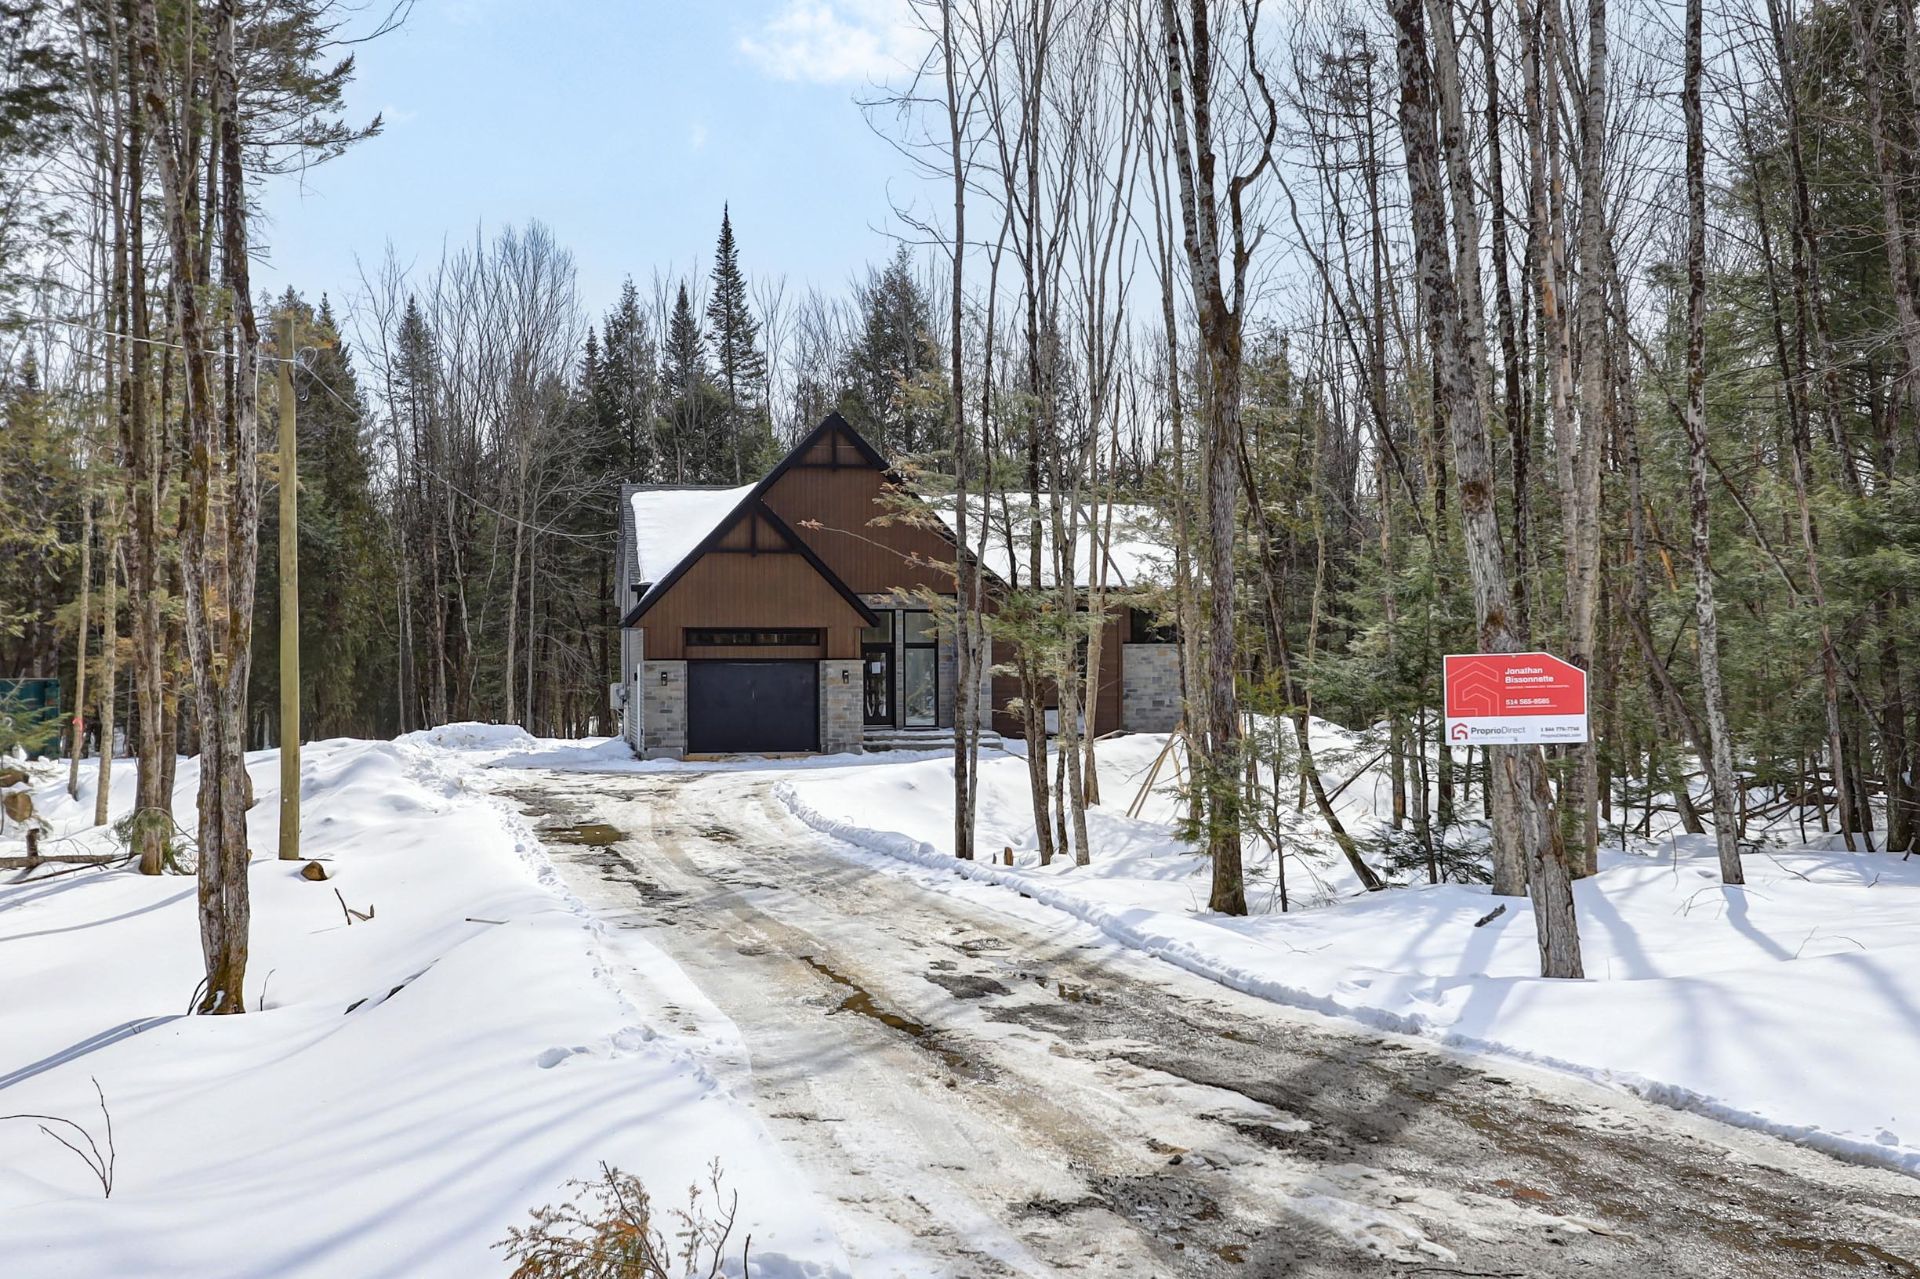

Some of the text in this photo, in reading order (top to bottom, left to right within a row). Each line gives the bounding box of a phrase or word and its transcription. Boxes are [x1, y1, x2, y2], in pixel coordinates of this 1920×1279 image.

[1505, 667, 1543, 675] Jonathan
[1505, 676, 1554, 684] Bissonnette
[1471, 727, 1526, 736] ProprioDirect
